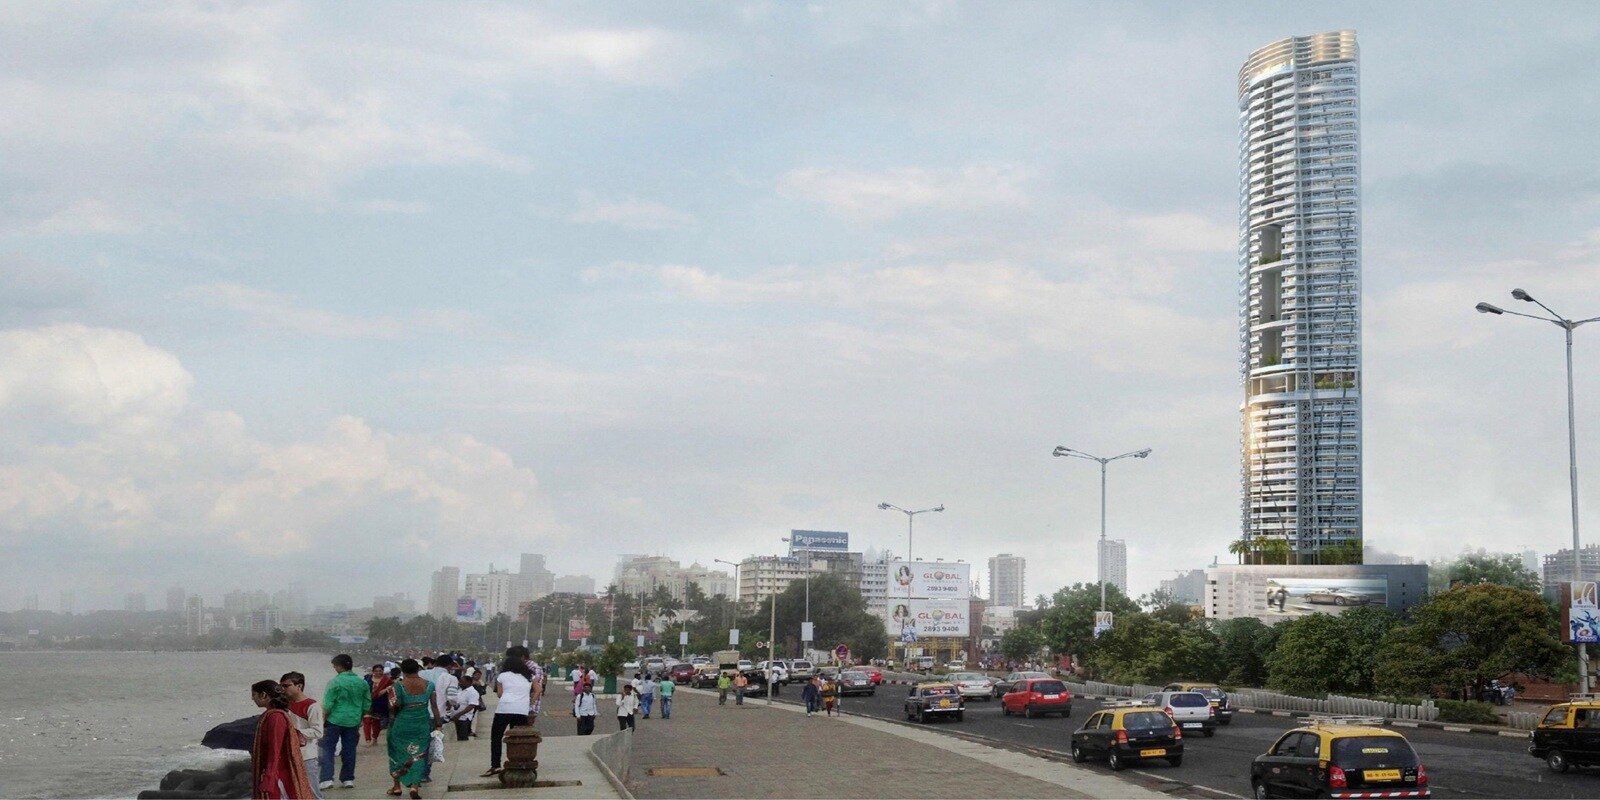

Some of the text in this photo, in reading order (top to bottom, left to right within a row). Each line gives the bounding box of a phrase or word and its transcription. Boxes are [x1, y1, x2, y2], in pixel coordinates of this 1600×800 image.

[795, 534, 848, 545] Panasonic
[923, 571, 962, 580] GLOBAL
[918, 610, 965, 620] GLOBAL
